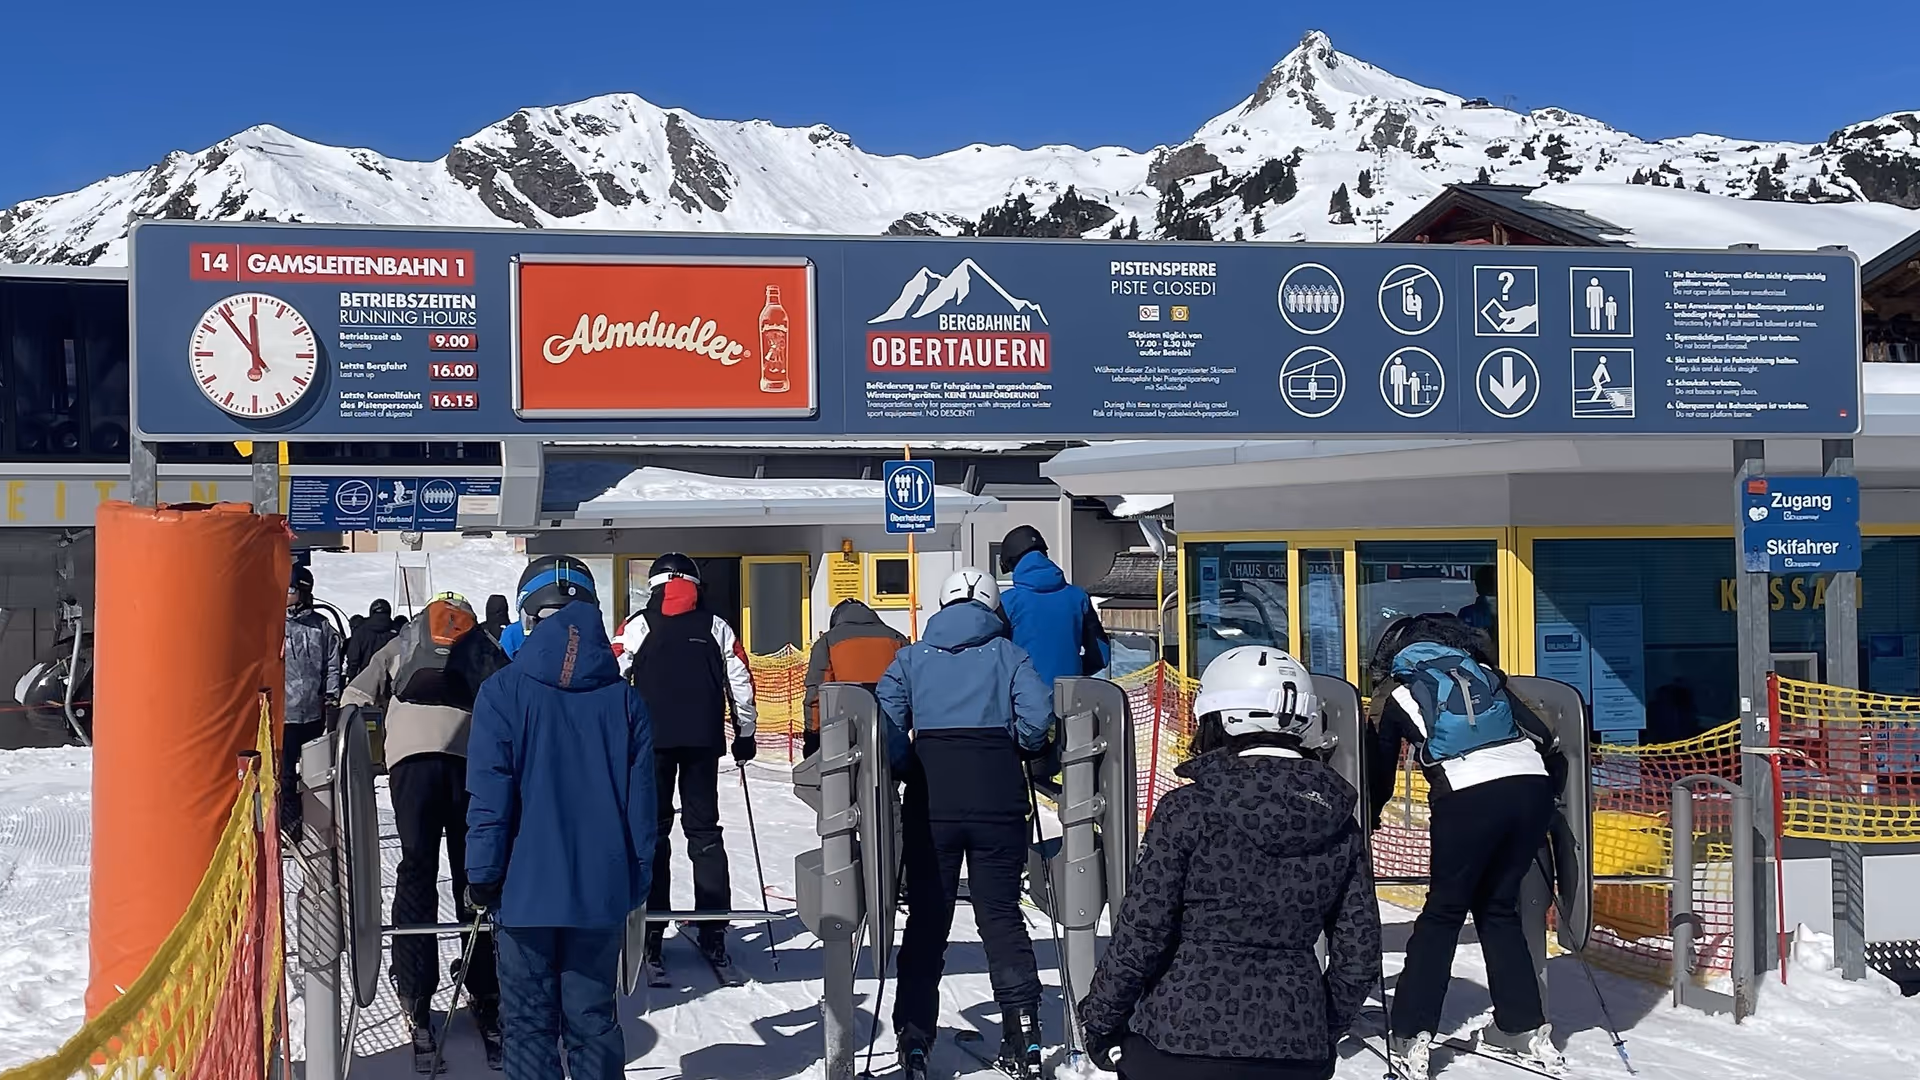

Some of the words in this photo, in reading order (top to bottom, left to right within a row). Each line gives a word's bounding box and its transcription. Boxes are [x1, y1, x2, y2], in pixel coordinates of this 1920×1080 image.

[200, 252, 229, 272] 14
[247, 253, 448, 277] GAMSLEITENBAHN
[455, 258, 465, 277] 1
[1110, 261, 1217, 277] PISTENSPERRE
[1111, 280, 1147, 295] PISTE
[1152, 280, 1216, 296] CLOSED!
[340, 292, 476, 309] BETRIEBSZEITEN
[340, 309, 418, 325] RUNNING
[422, 310, 477, 326] HOURS
[939, 313, 1031, 332] BERGBAHNEN
[339, 332, 389, 340] Betriebszeit
[435, 335, 469, 347] 9.00
[542, 310, 745, 366] Almdudler
[871, 336, 1046, 368] OBERTAUERN
[340, 362, 365, 372] Letzte
[366, 362, 407, 371] Bergfahrt
[432, 365, 474, 377] 16.00
[367, 391, 421, 399] Kontrollfahrt
[433, 395, 474, 407] 16.15
[340, 401, 356, 409] des
[357, 401, 423, 411] Pistenpersonals
[1771, 492, 1832, 511] Zugang
[1766, 539, 1839, 555] Skifahrer
[1235, 563, 1261, 577] HAUS
